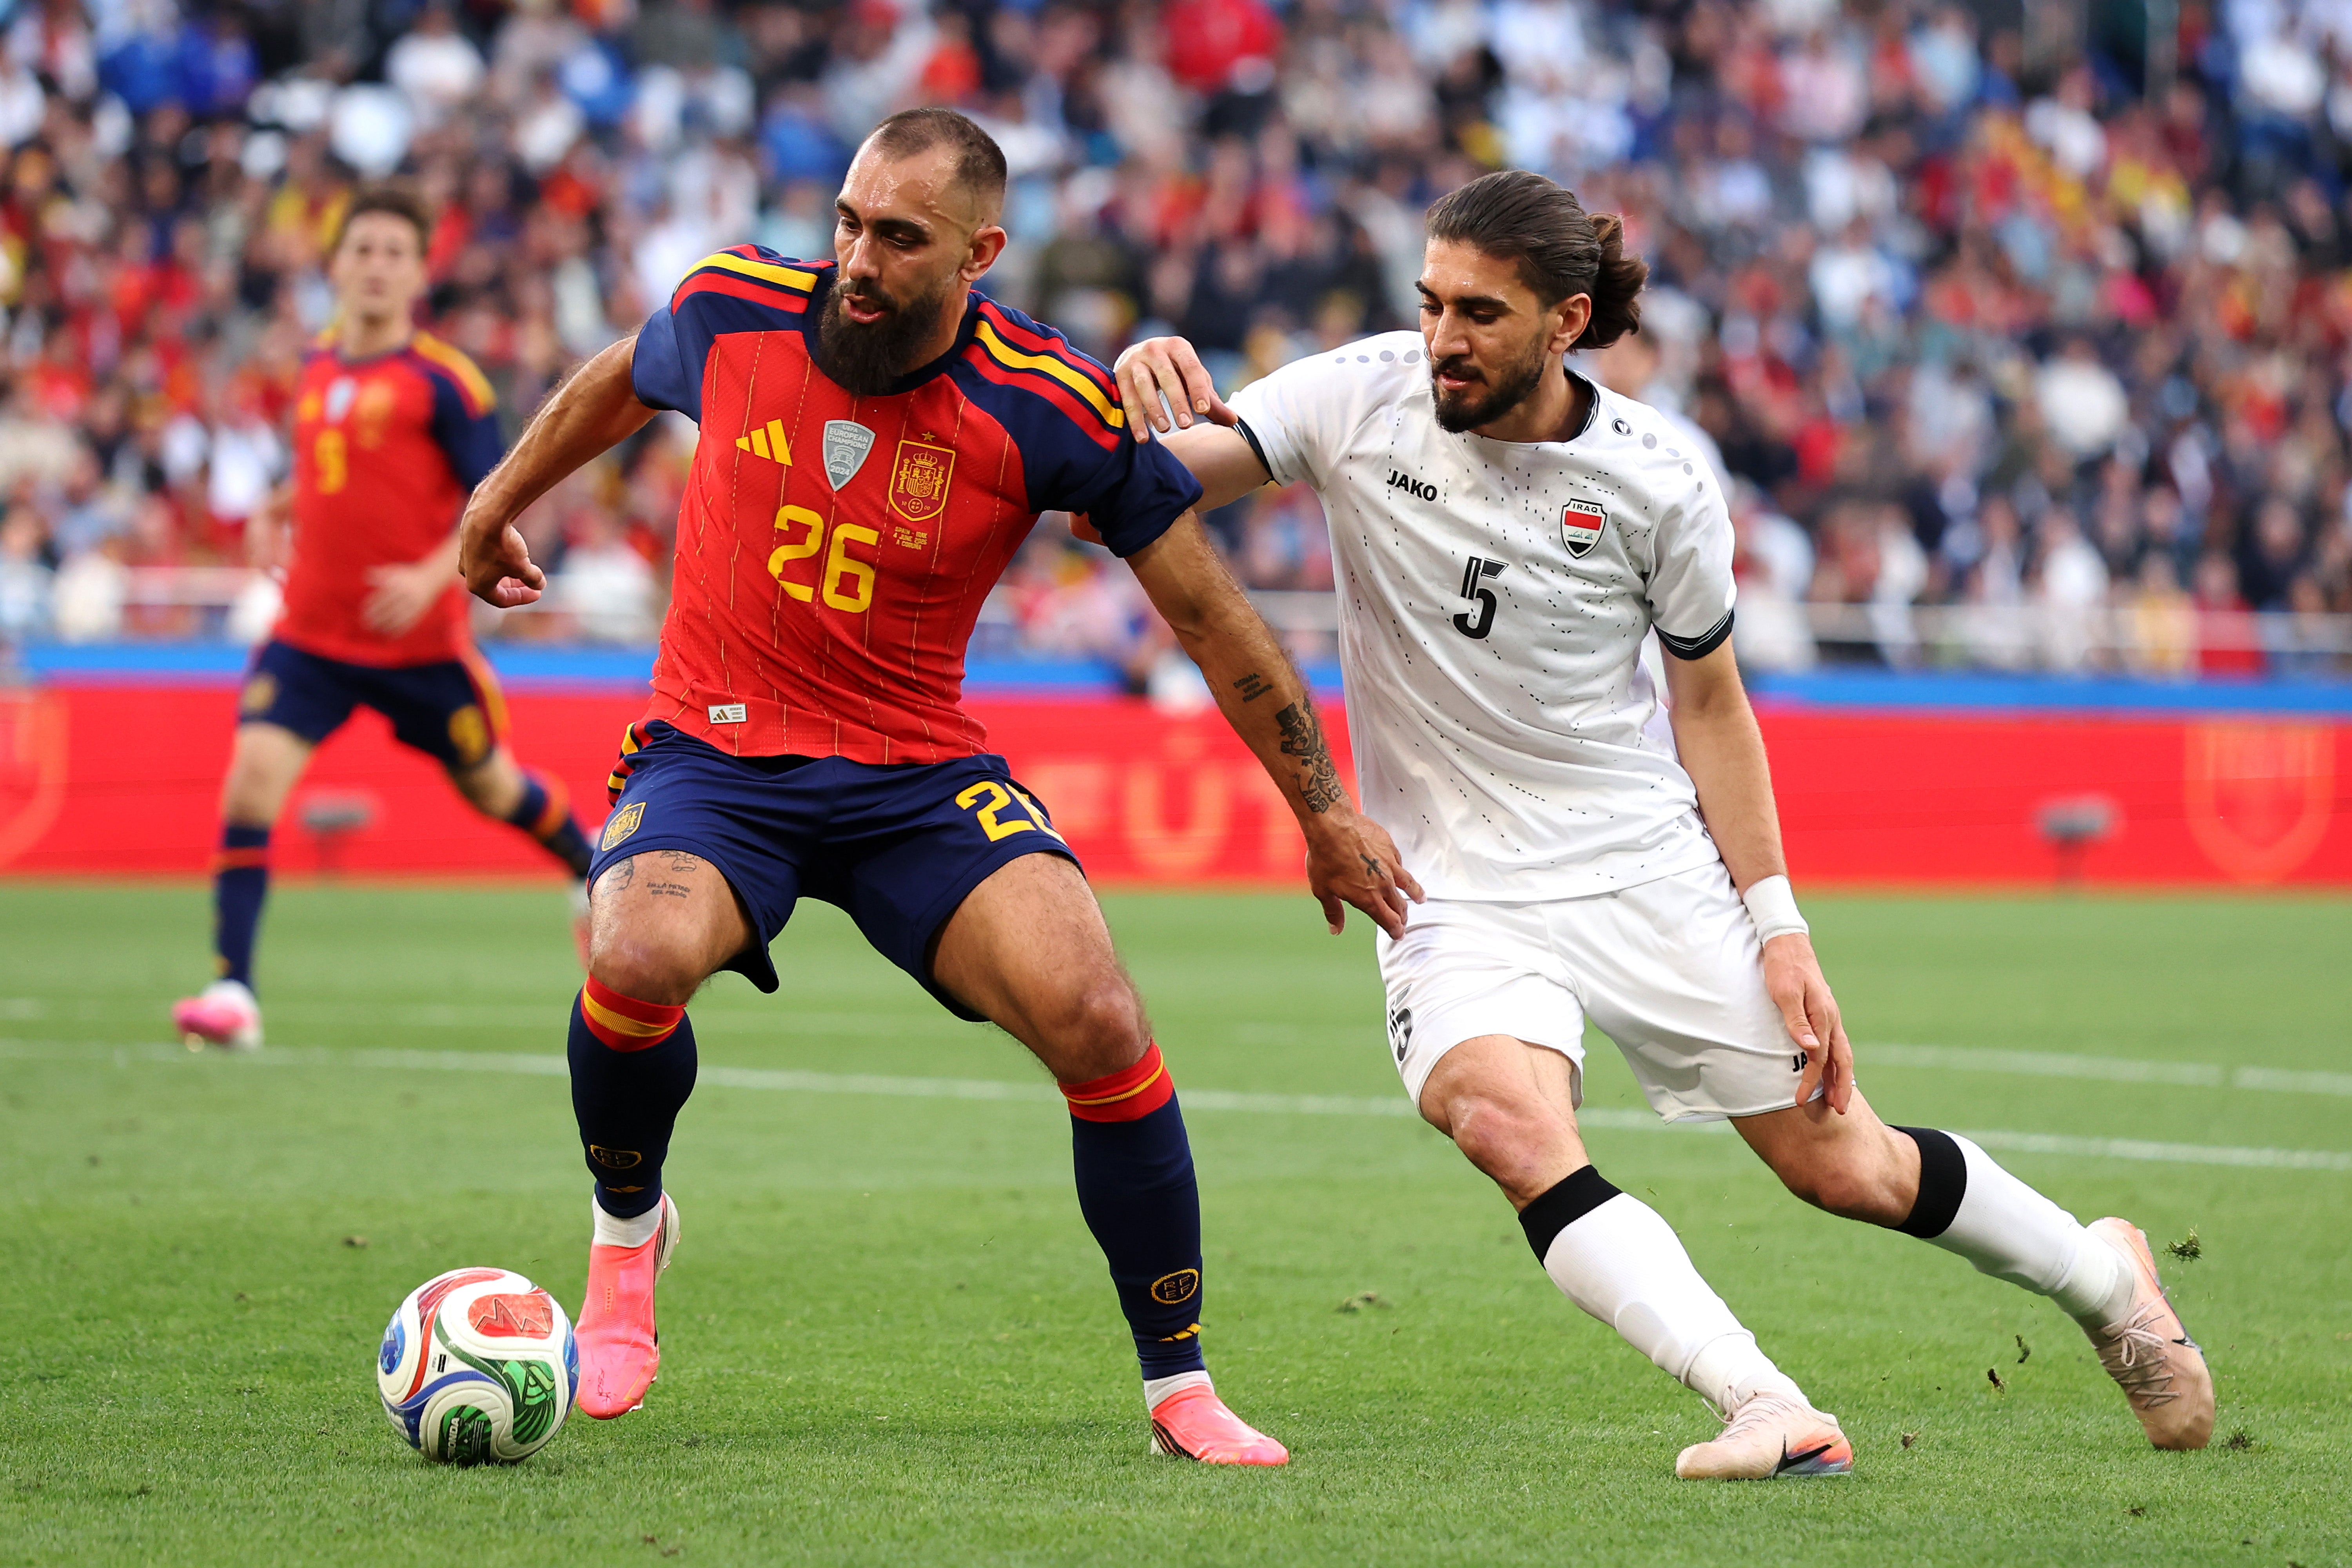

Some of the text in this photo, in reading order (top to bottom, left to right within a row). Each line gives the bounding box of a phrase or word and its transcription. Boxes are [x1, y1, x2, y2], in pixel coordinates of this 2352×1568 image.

[829, 428, 869, 443] EUROPEAN
[843, 424, 858, 433] UEFA
[828, 435, 867, 450] CHAMPIONS
[830, 464, 850, 476] 2024
[1387, 470, 1437, 502] JAKO
[1573, 503, 1598, 513] IRAQ
[767, 504, 880, 613] 26
[1453, 555, 1510, 639] 5
